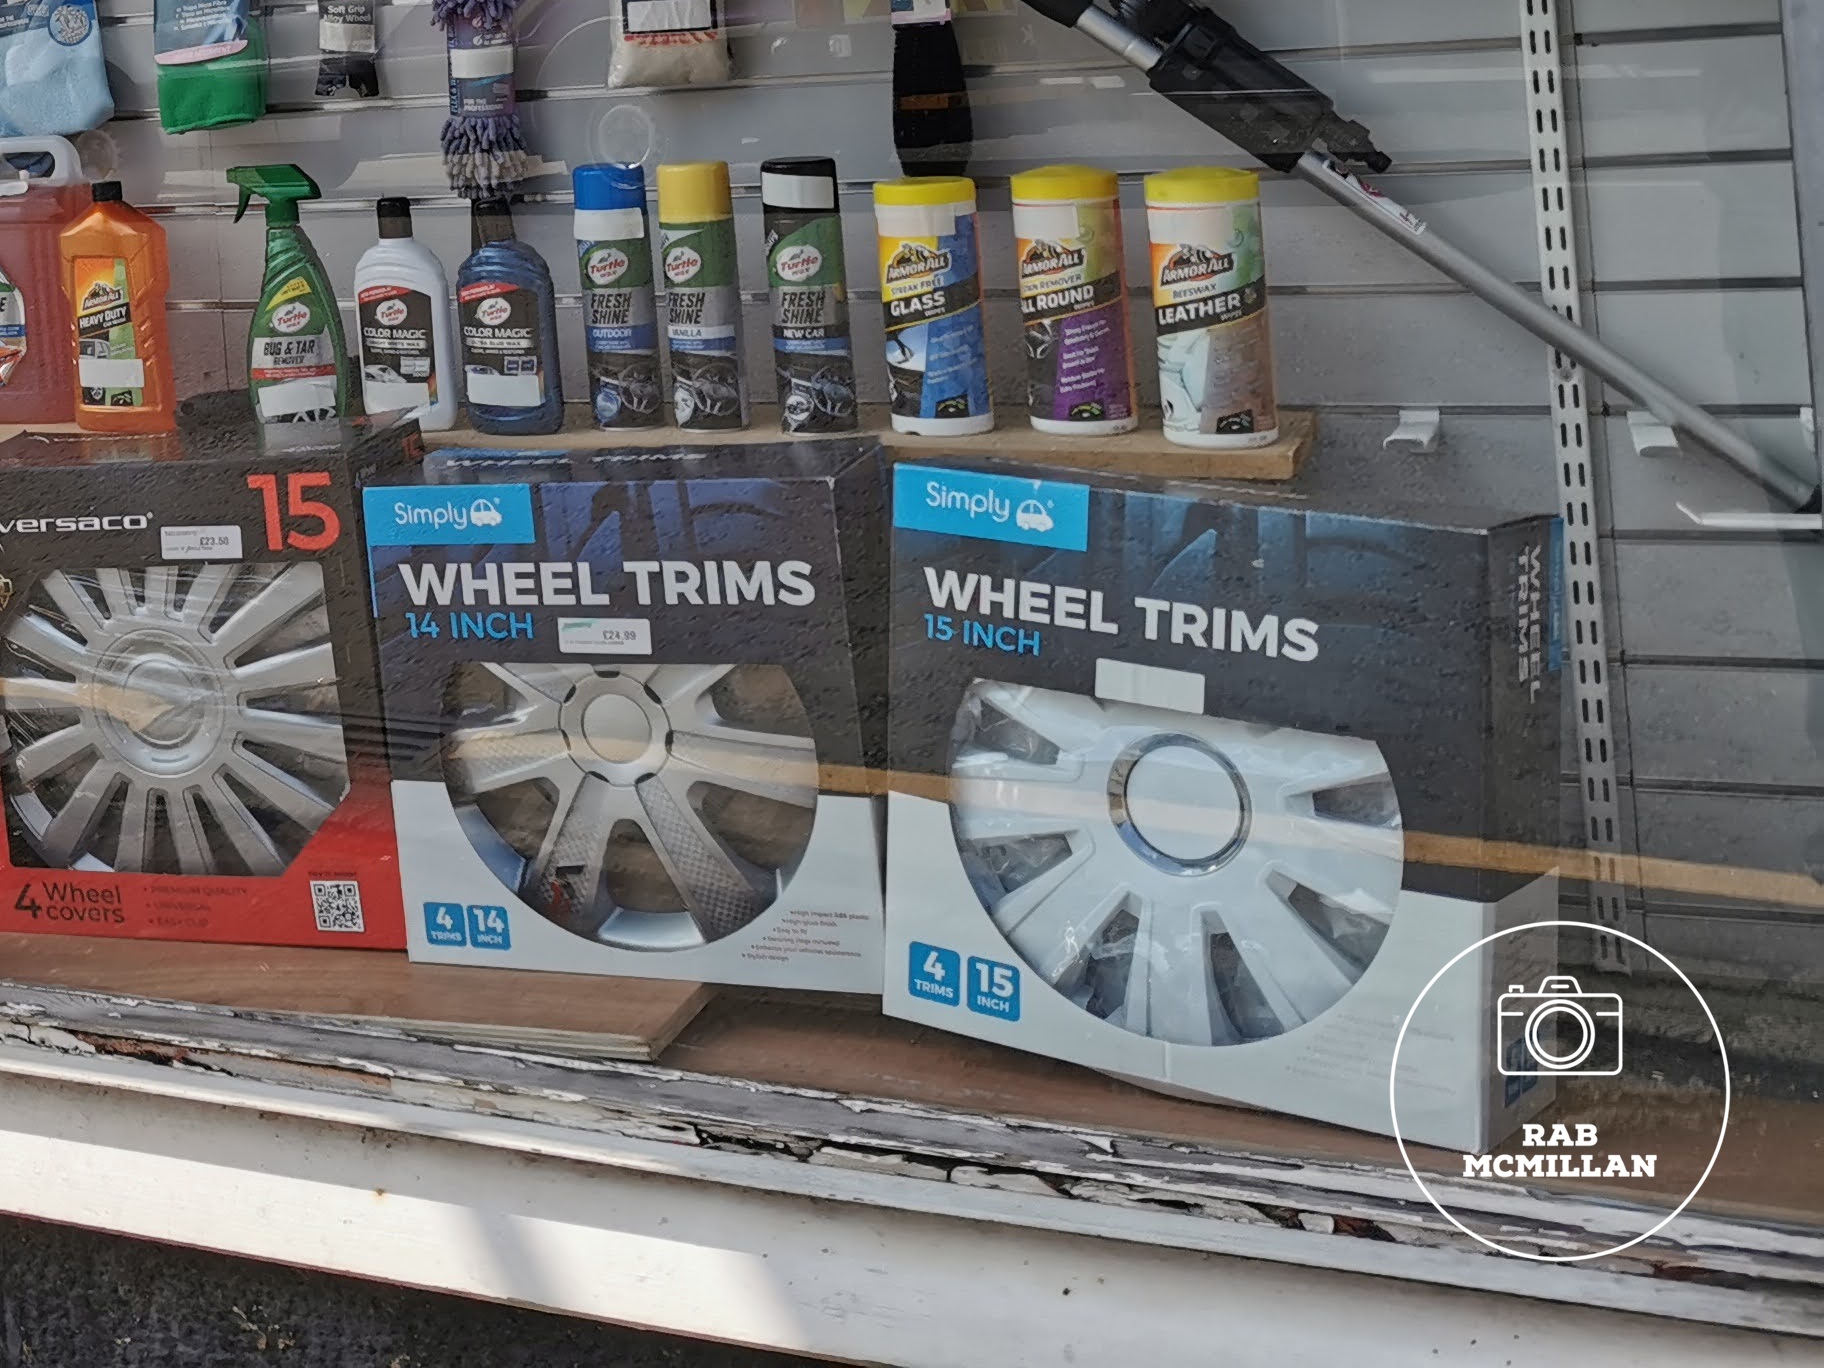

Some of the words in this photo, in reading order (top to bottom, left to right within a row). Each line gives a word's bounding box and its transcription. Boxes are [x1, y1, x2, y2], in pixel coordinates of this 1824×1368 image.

[327, 4, 346, 14] Soft
[589, 258, 626, 275] Turtle
[666, 257, 699, 274] Turtle
[780, 255, 819, 272] Turtle
[1040, 273, 1083, 292] REMOVER
[1172, 283, 1217, 300] BEESWAX
[590, 292, 632, 309] FRESH
[668, 291, 705, 309] FRESH
[781, 291, 826, 308] FRESH
[890, 291, 946, 317] GLASS
[1037, 285, 1095, 311] ROUND
[79, 312, 104, 329] HEAVY
[104, 306, 127, 320] DUTY
[276, 310, 311, 326] Turtle
[591, 308, 630, 325] SHINE
[669, 308, 703, 325] SHINE
[782, 307, 824, 325] SHINE
[1158, 293, 1241, 326] LEATHER
[363, 327, 393, 337] COLOR
[393, 328, 427, 339] MAGIC
[463, 326, 493, 338] COLOR
[494, 327, 532, 338] MAGIC
[264, 339, 282, 356] BUG
[295, 338, 315, 354] TAR
[247, 471, 342, 552] 15
[926, 481, 1010, 524] Simply
[394, 499, 468, 531] Simply
[398, 560, 611, 607] WHEEL
[622, 560, 816, 607] TRIMS
[923, 566, 1118, 638] WHEEL
[1134, 595, 1320, 662] TRIMS
[405, 611, 440, 639] 14
[451, 611, 534, 640] INCH
[924, 612, 956, 643] 15
[961, 616, 1041, 657] INCH
[13, 883, 43, 920] 4
[42, 881, 122, 905] Wheel
[46, 901, 125, 924] covers
[434, 907, 453, 930] 4
[472, 906, 504, 932] 14
[431, 931, 463, 943] TRIMS
[476, 932, 503, 944] INCH
[923, 950, 945, 981] 4
[976, 960, 1015, 995] 15
[914, 978, 955, 1000] TRIMS
[976, 992, 1011, 1014] INCH
